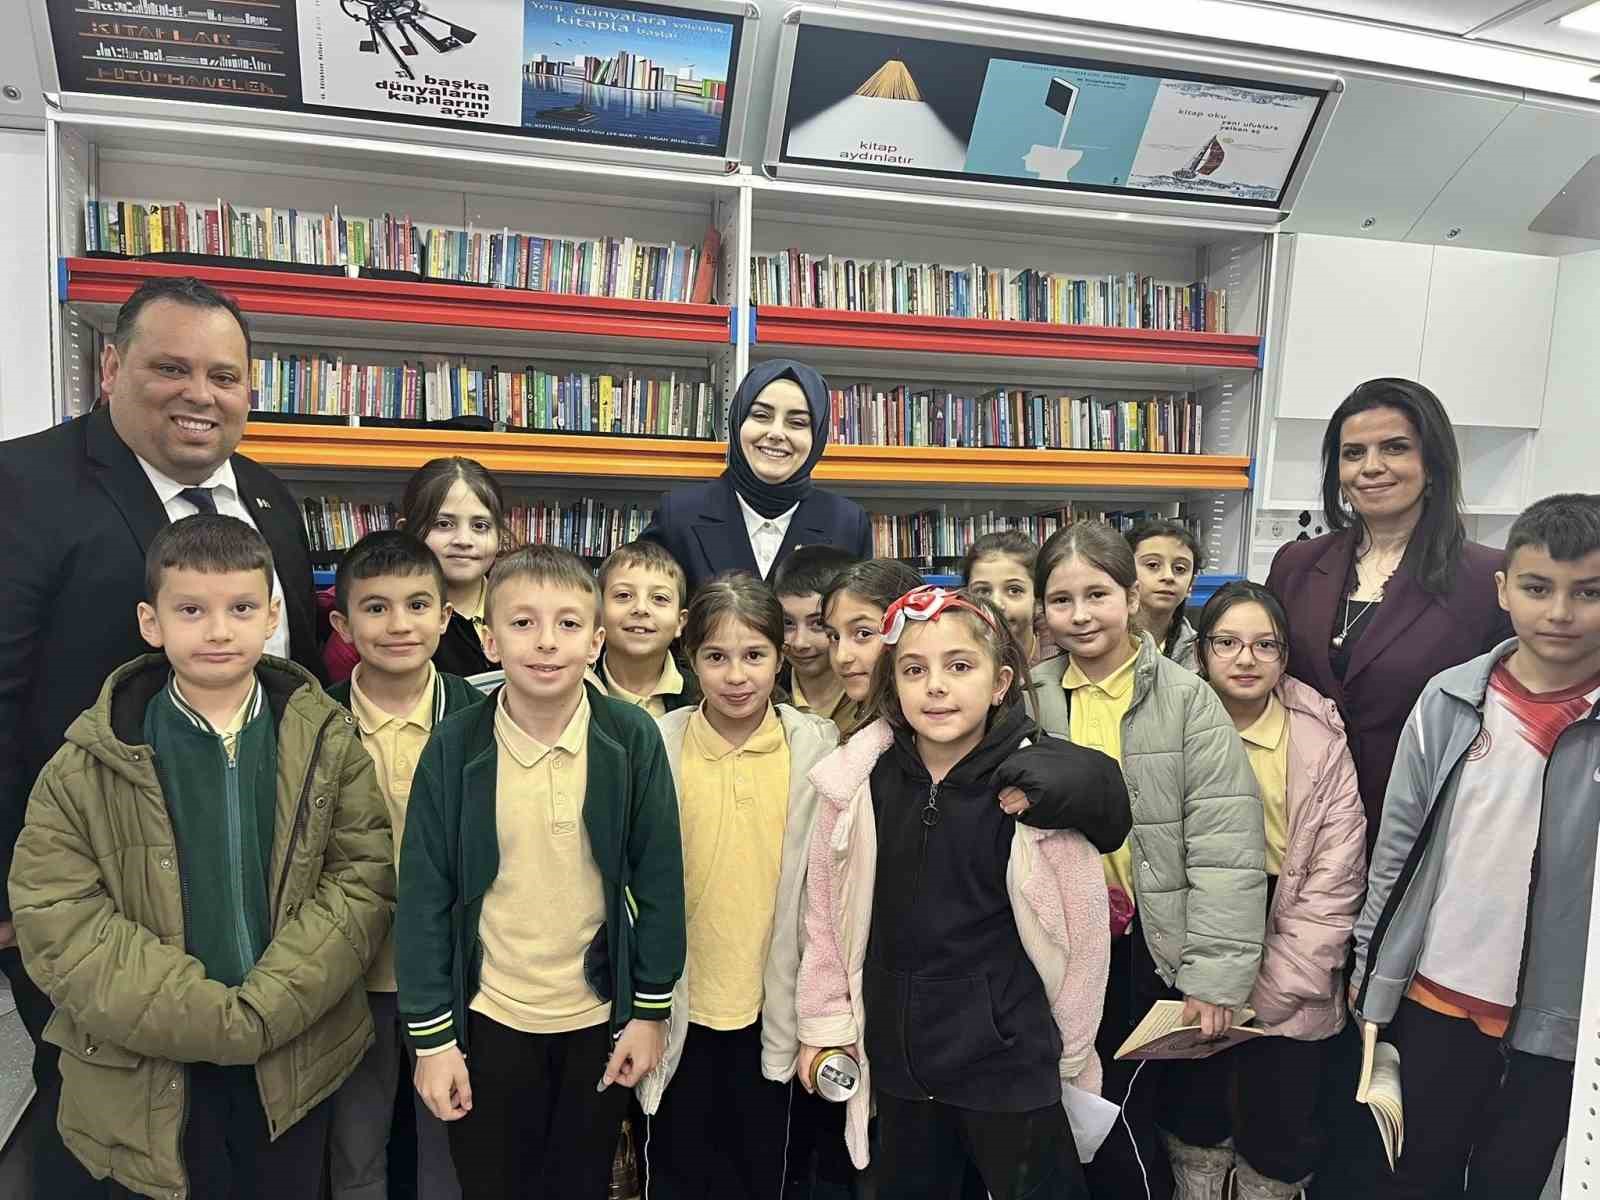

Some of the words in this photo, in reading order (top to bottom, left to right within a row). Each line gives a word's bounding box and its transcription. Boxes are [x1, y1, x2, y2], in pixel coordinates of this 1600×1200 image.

[556, 13, 629, 33] kitapla
[375, 80, 490, 101] dünyaların
[424, 74, 489, 91] başka
[387, 90, 490, 111] kapılarını
[440, 106, 489, 119] açar
[1178, 107, 1205, 118] kitap
[1207, 112, 1227, 120] oku
[859, 140, 898, 154] kitap
[839, 150, 914, 165] aydınlatır
